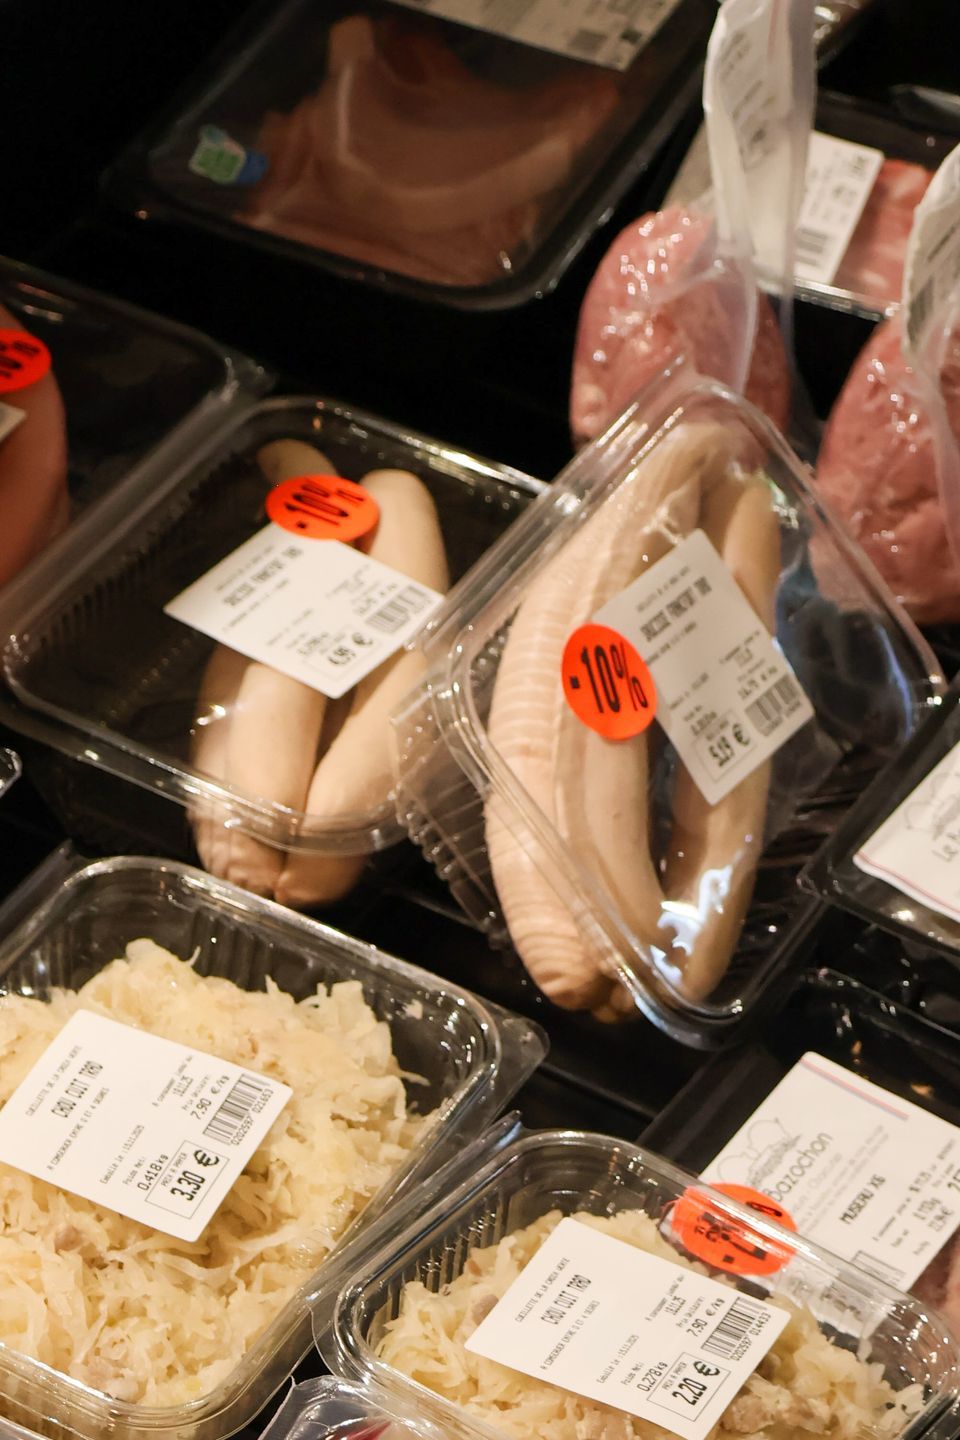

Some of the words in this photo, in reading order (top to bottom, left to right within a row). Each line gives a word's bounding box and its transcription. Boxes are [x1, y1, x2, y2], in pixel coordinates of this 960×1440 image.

[570, 642, 649, 714] -10%
[190, 1097, 212, 1120] 7.90
[170, 1170, 206, 1201] 3.30
[193, 1149, 220, 1167] €
[553, 1290, 577, 1309] CUIT
[686, 1318, 708, 1337] 7.90
[672, 1377, 708, 1406] 2.20
[693, 1361, 721, 1377] €
